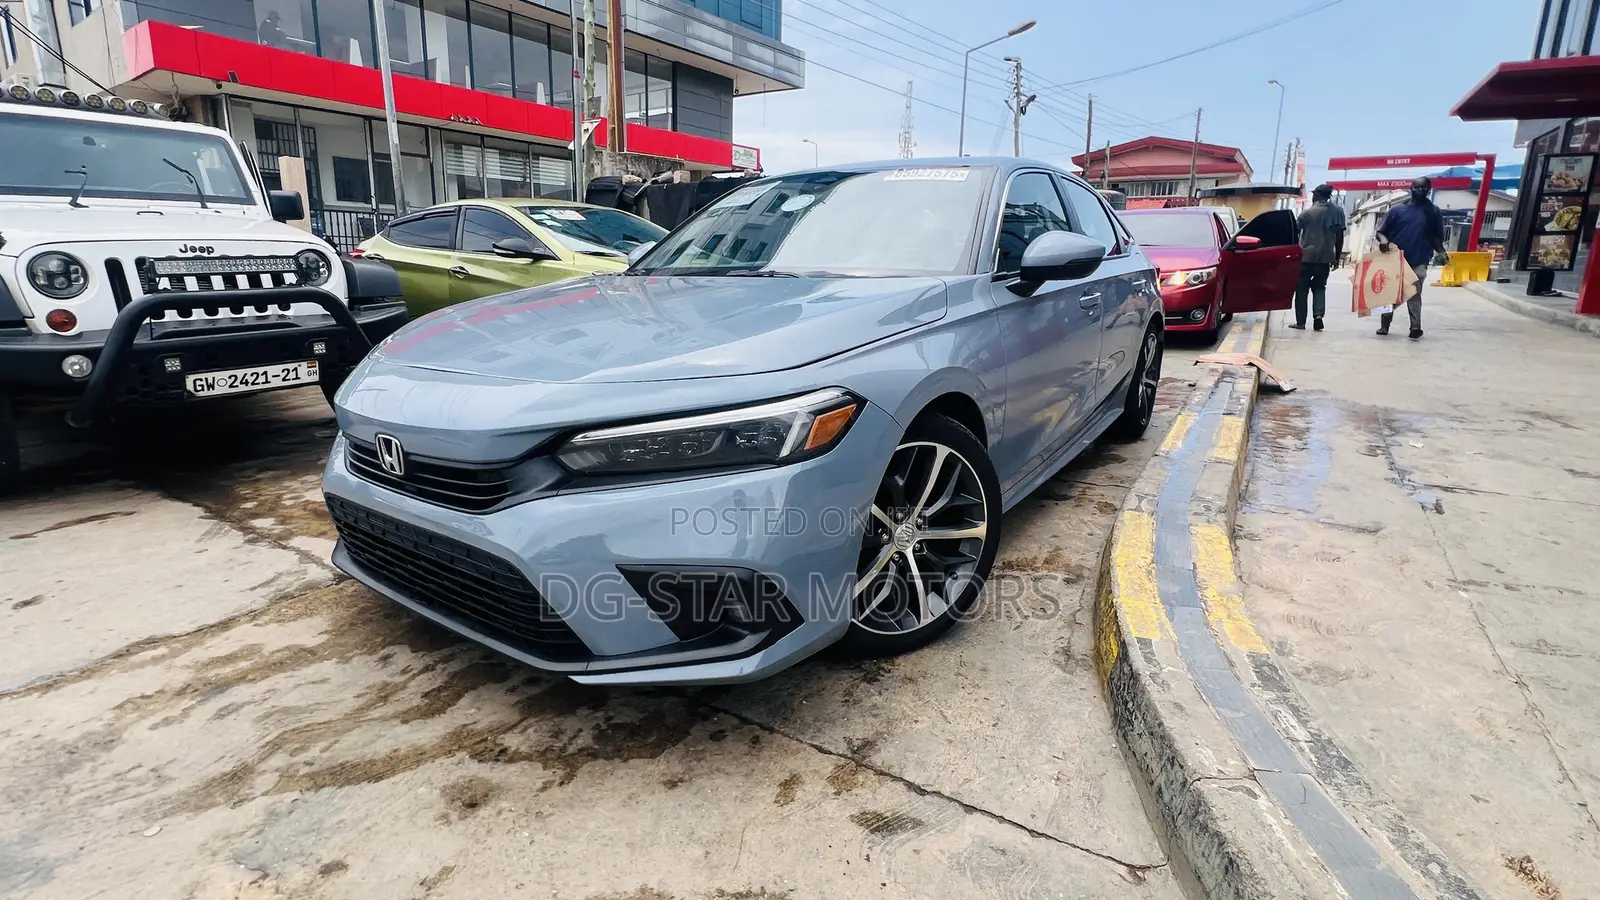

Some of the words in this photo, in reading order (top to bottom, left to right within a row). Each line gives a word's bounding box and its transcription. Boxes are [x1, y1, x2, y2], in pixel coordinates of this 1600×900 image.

[179, 244, 215, 255] Jeep
[307, 369, 318, 377] GH
[192, 377, 216, 393] GW
[228, 366, 301, 389] 2421-21
